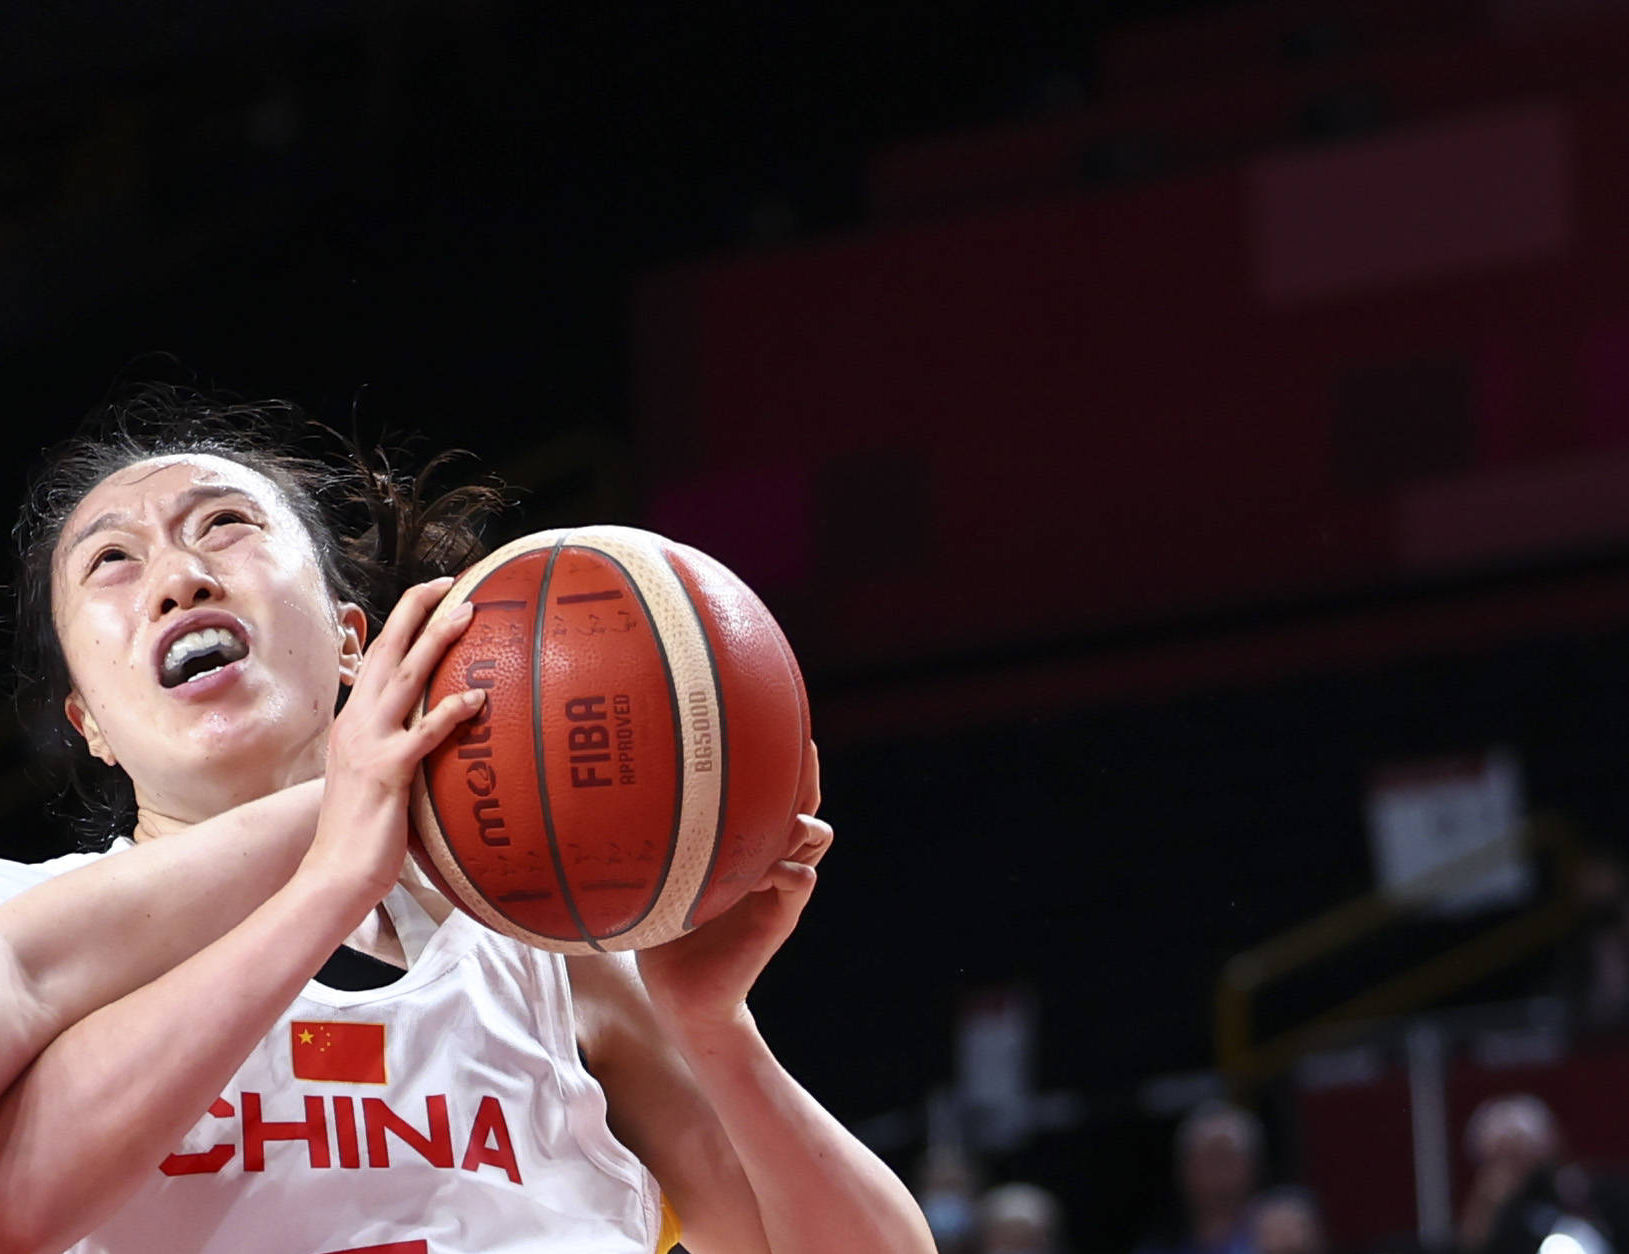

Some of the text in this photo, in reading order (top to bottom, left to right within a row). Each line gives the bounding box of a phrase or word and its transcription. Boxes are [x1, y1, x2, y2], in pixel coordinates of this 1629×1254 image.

[565, 695, 613, 788] FIBA
[613, 695, 636, 785] APPROVED
[688, 690, 713, 773] BG5000
